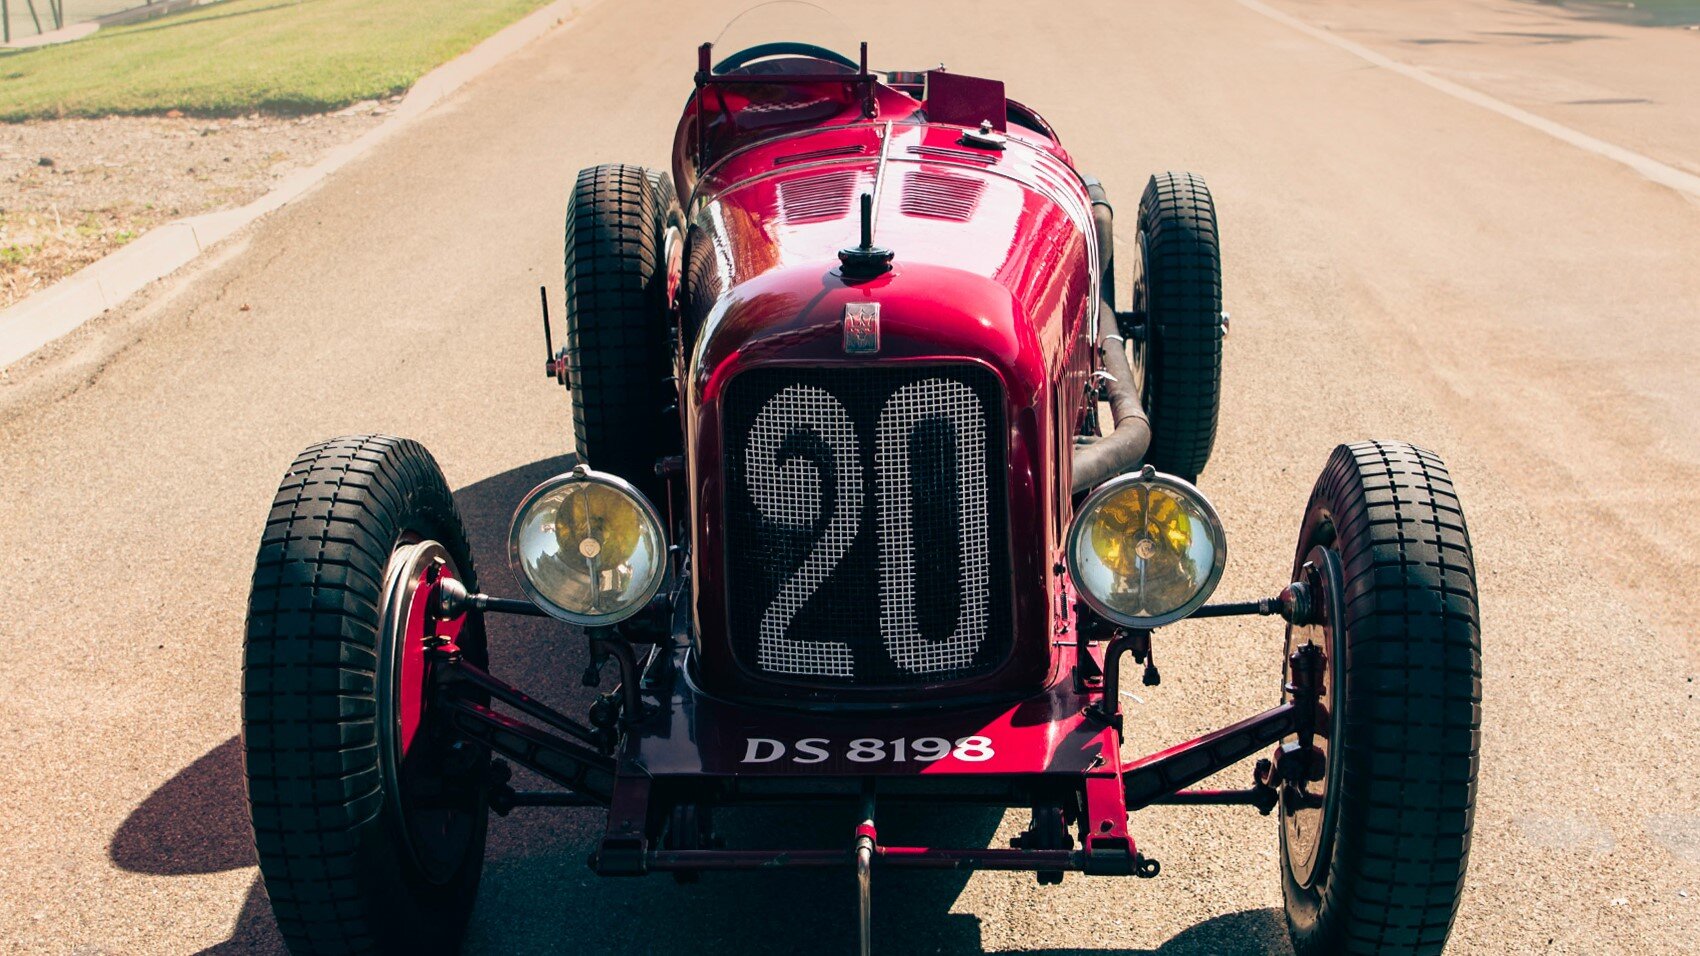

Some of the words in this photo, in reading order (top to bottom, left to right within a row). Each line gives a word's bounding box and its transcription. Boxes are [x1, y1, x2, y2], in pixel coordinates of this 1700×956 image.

[745, 377, 990, 679] 20
[740, 737, 830, 764] DS
[846, 735, 995, 762] 8198
